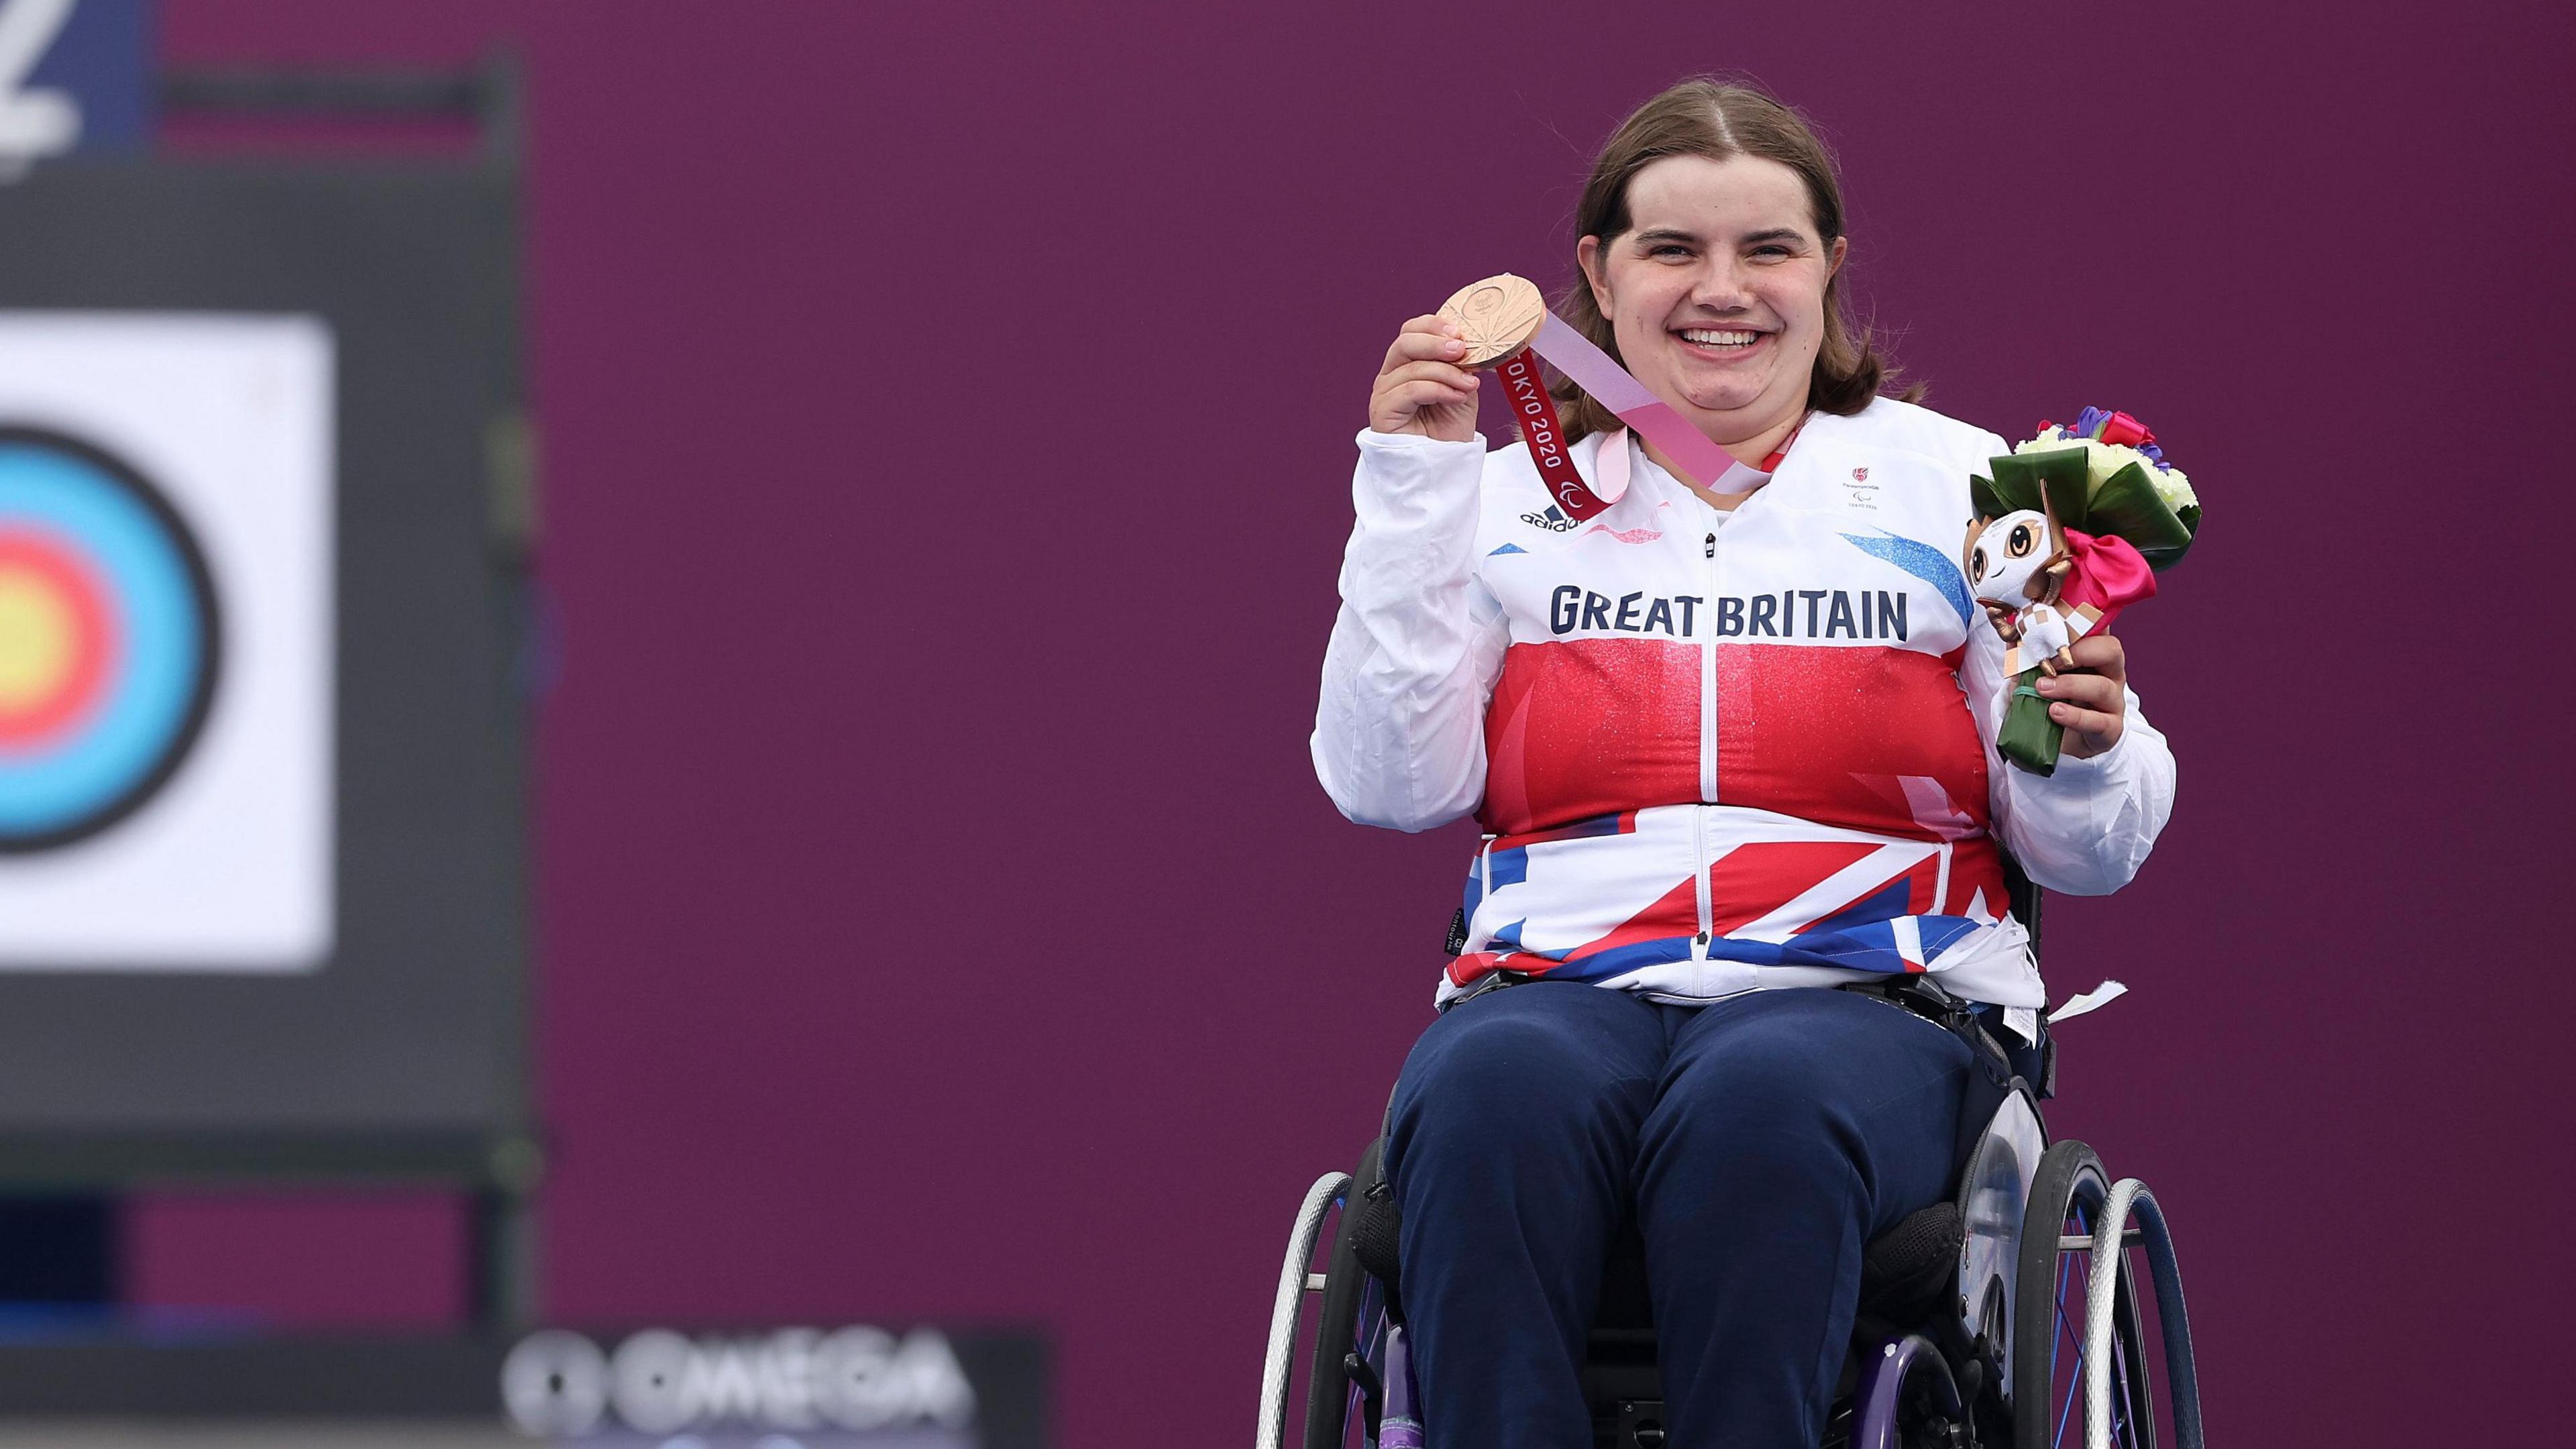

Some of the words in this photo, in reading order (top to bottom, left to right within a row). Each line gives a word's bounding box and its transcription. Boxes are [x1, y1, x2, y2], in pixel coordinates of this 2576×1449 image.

[1531, 418, 1562, 468] 2020
[1520, 513, 1584, 532] adida
[1550, 585, 1703, 637] GREAT
[1716, 589, 1907, 643] BRITAIN
